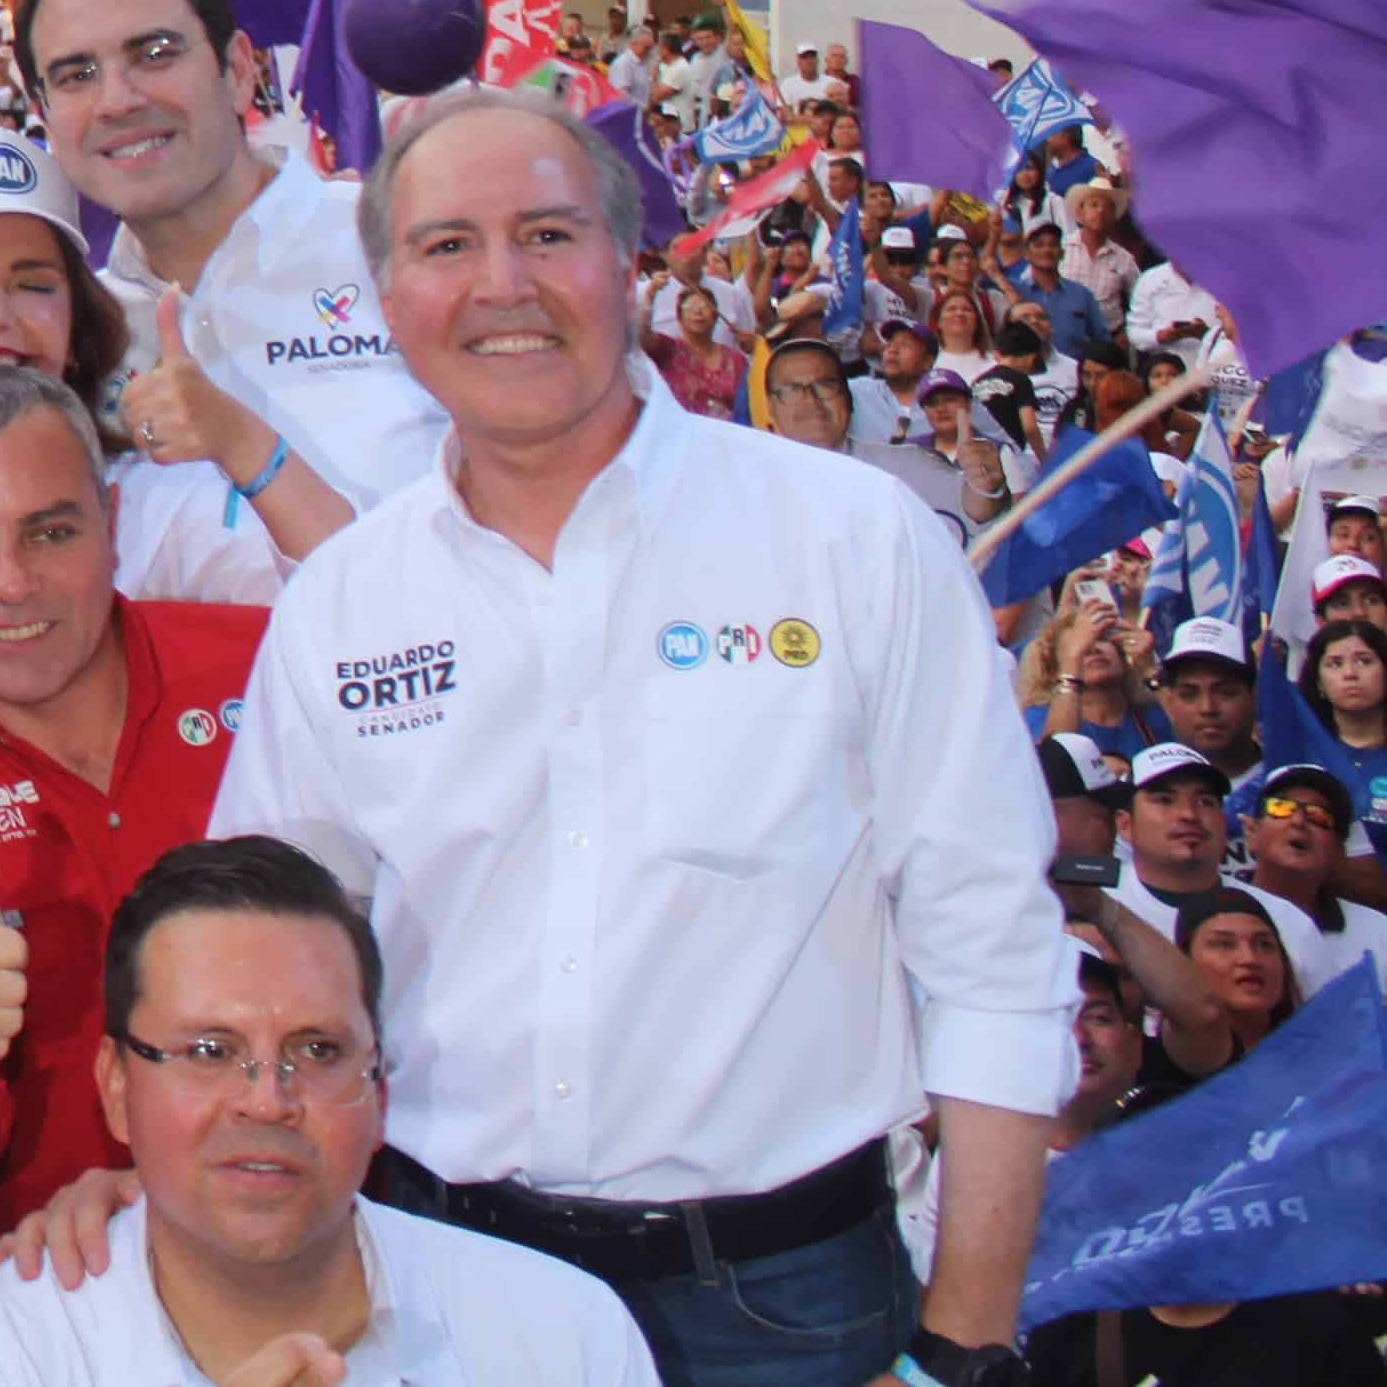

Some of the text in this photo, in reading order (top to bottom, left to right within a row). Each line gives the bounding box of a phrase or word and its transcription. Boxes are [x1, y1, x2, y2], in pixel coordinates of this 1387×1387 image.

[718, 628, 758, 656] PRI
[336, 640, 455, 679] EDUARDO
[338, 660, 457, 711] ORTIZ
[357, 711, 444, 738] SENADOR
